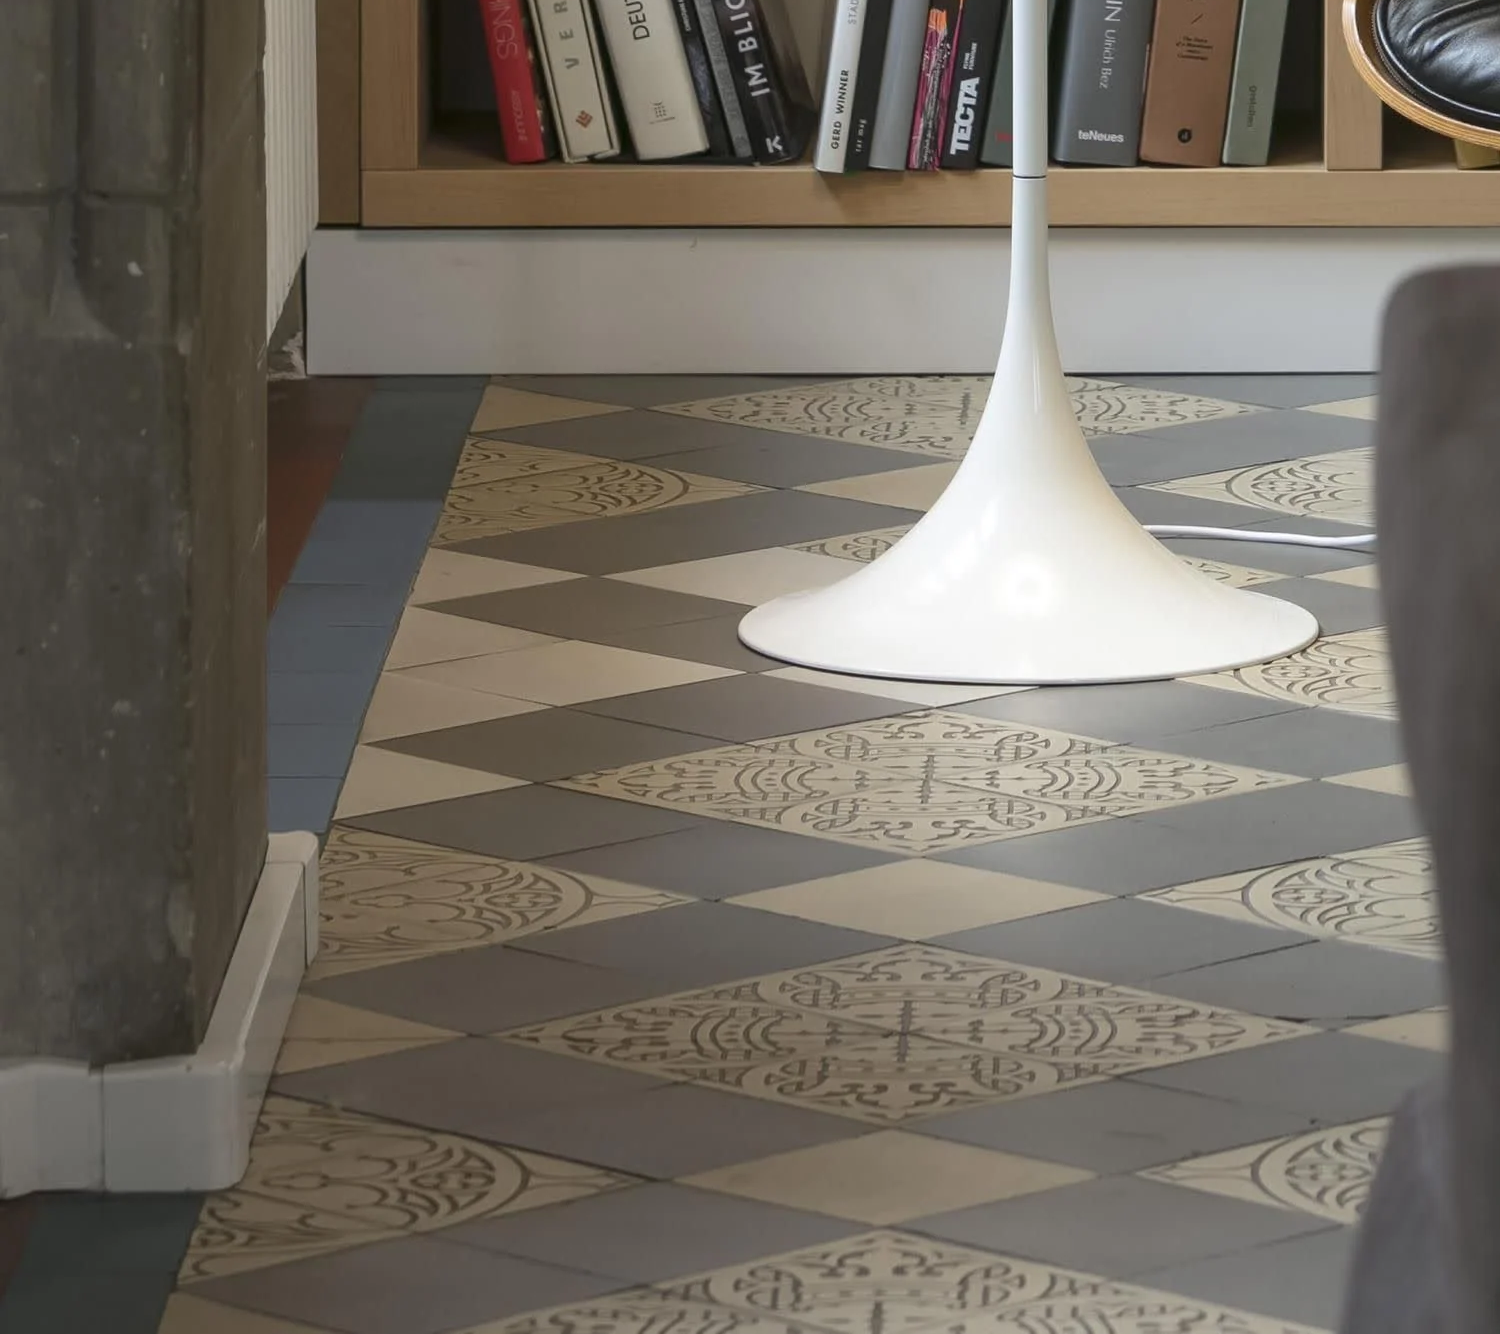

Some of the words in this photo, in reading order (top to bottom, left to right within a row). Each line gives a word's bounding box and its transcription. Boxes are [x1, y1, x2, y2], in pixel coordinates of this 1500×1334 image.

[745, 62, 770, 98] IM
[835, 69, 849, 115] WINNER
[950, 77, 980, 155] TECTA
[1078, 128, 1124, 143] teNeues
